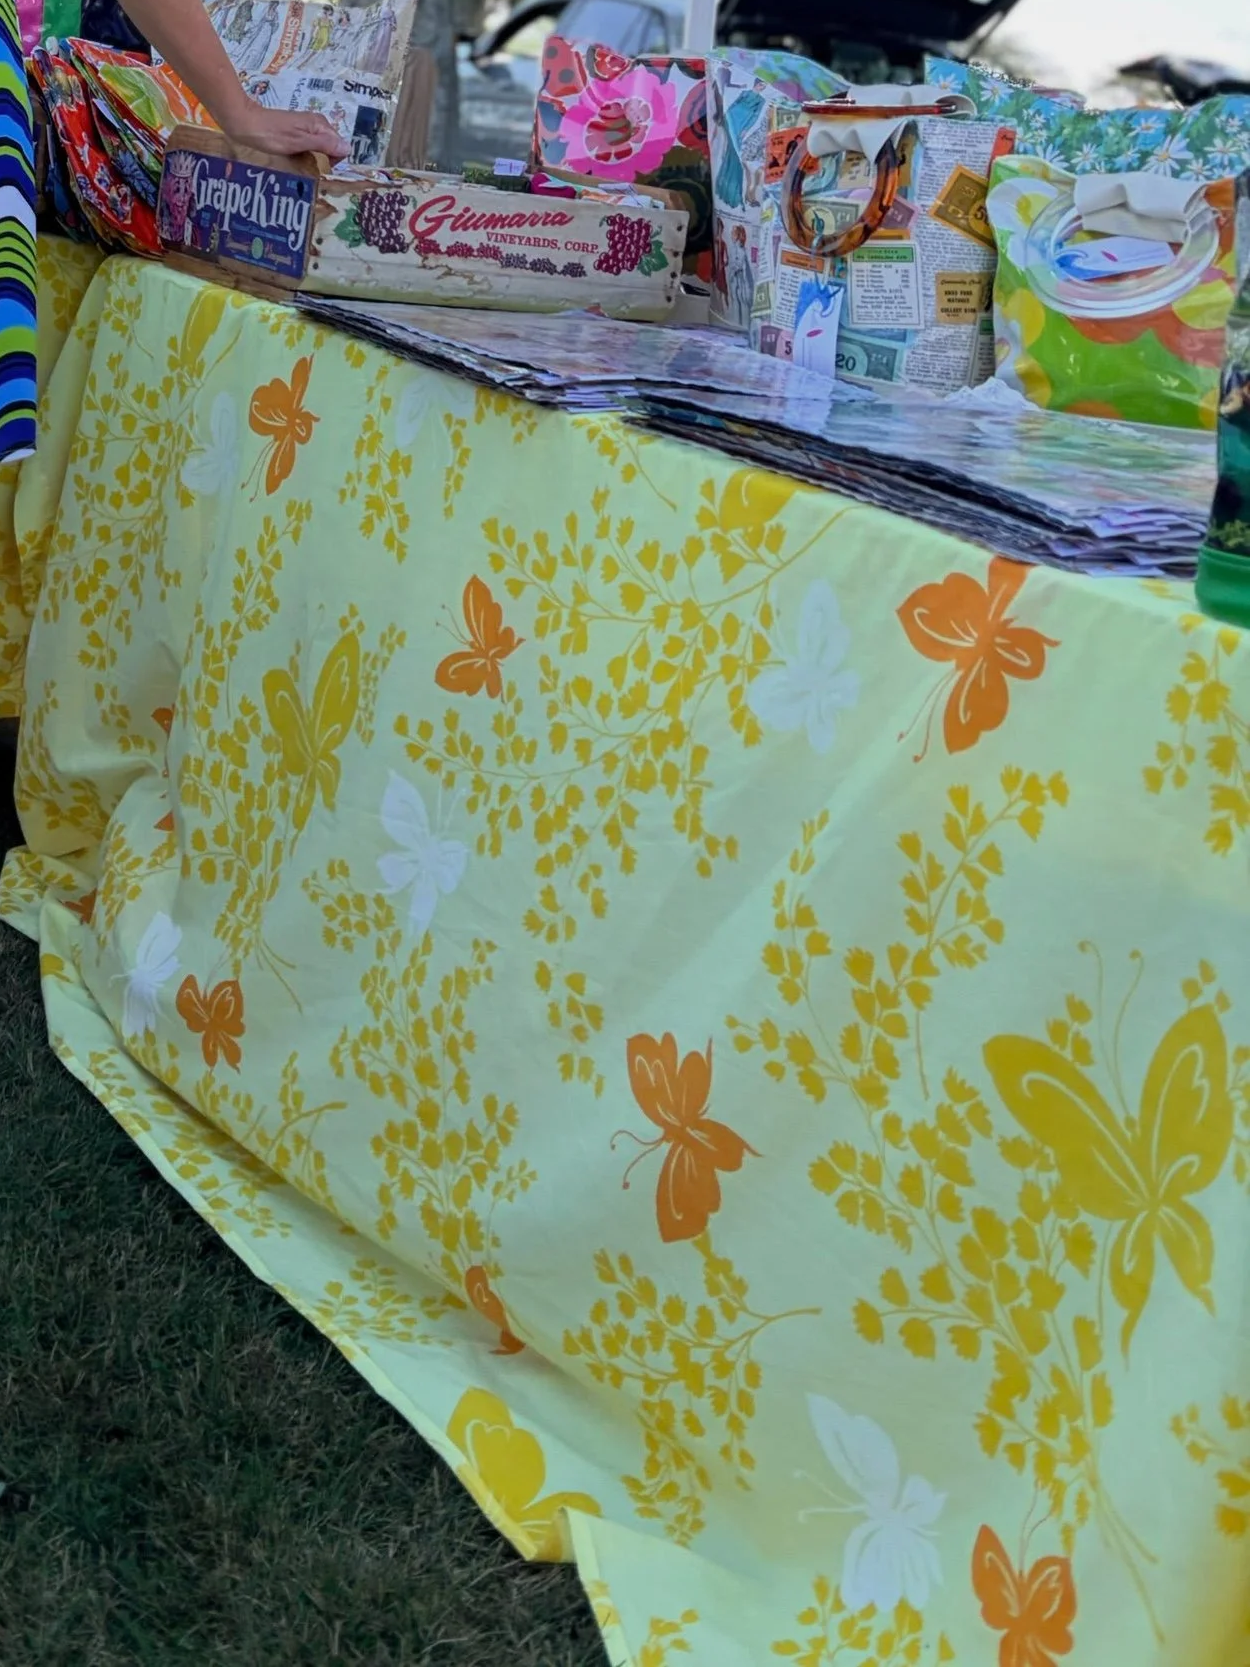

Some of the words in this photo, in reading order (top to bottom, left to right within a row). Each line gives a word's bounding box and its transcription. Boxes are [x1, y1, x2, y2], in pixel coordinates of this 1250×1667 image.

[408, 194, 575, 239] Giumarra
[486, 231, 561, 251] VINEYARDS,
[564, 240, 600, 254] CORP.
